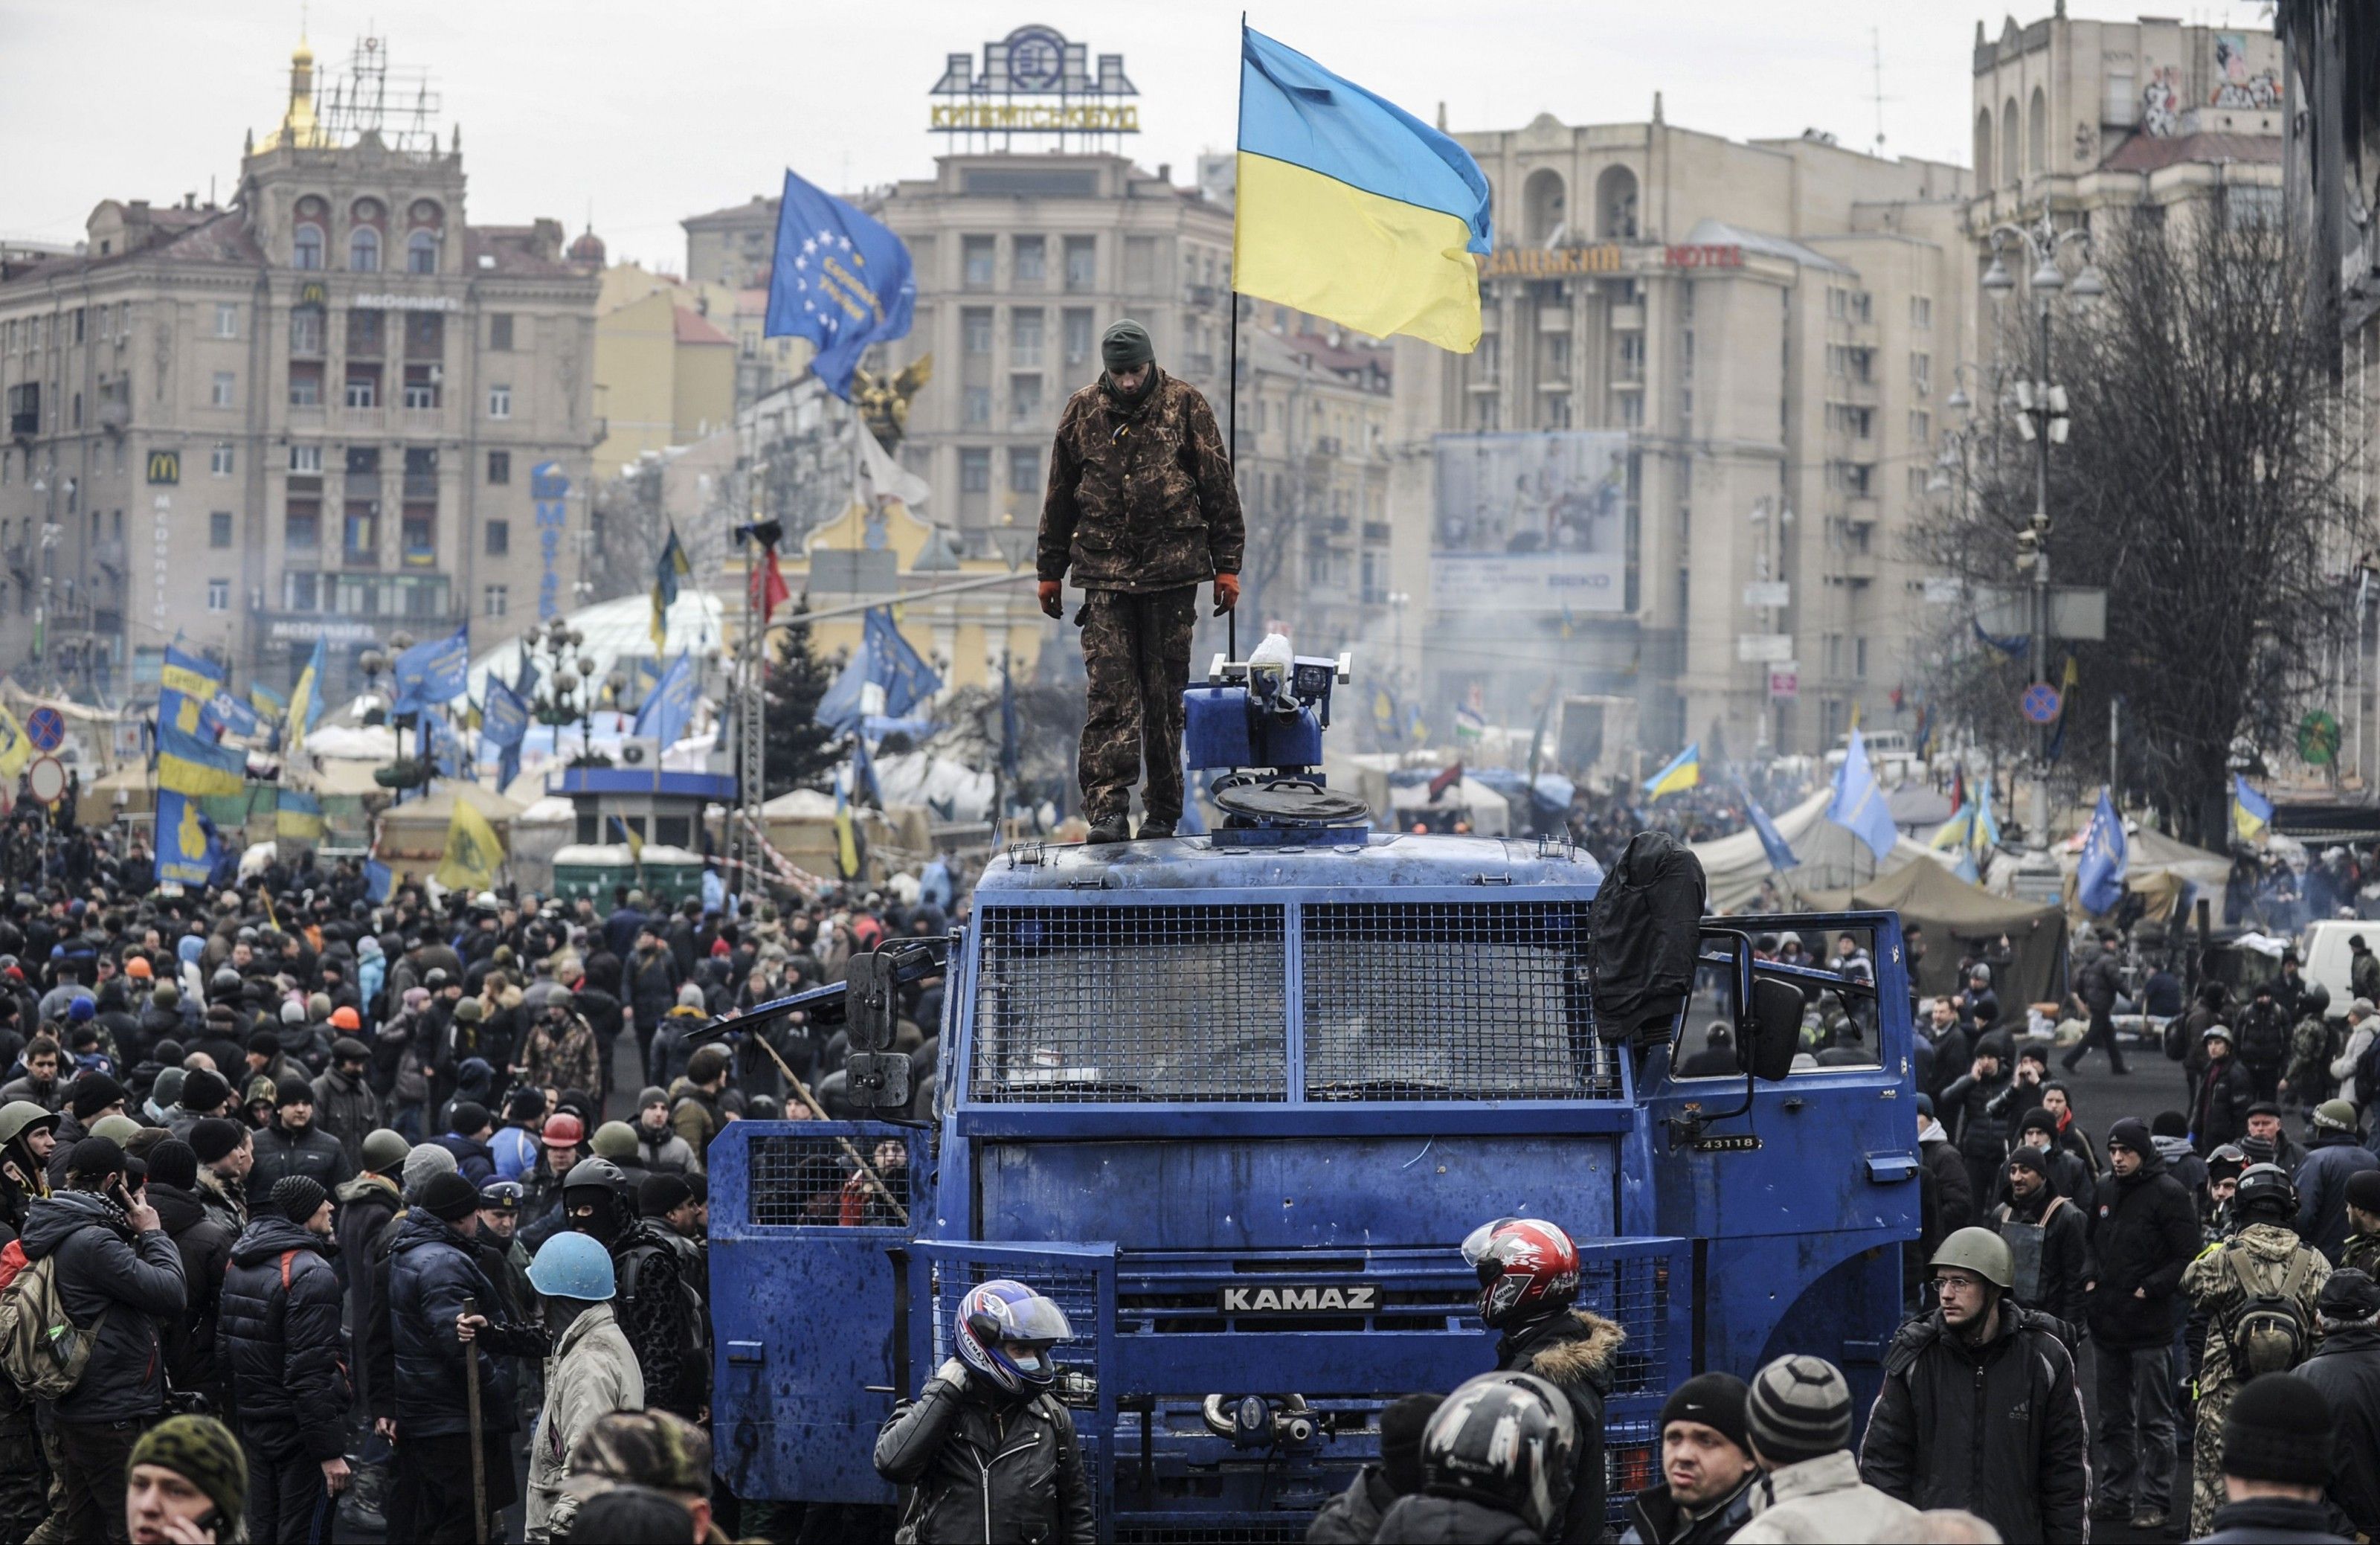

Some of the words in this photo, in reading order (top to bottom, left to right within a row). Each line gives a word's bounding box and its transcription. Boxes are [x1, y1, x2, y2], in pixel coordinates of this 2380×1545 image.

[931, 104, 1139, 129] КИЇВМІСЬКБУД
[1476, 242, 1621, 278] ЗАЦЬКИЙ
[1663, 244, 1741, 269] HOTEL
[1703, 1138, 1753, 1149] 43118
[1224, 1288, 1374, 1311] KAMAZ
